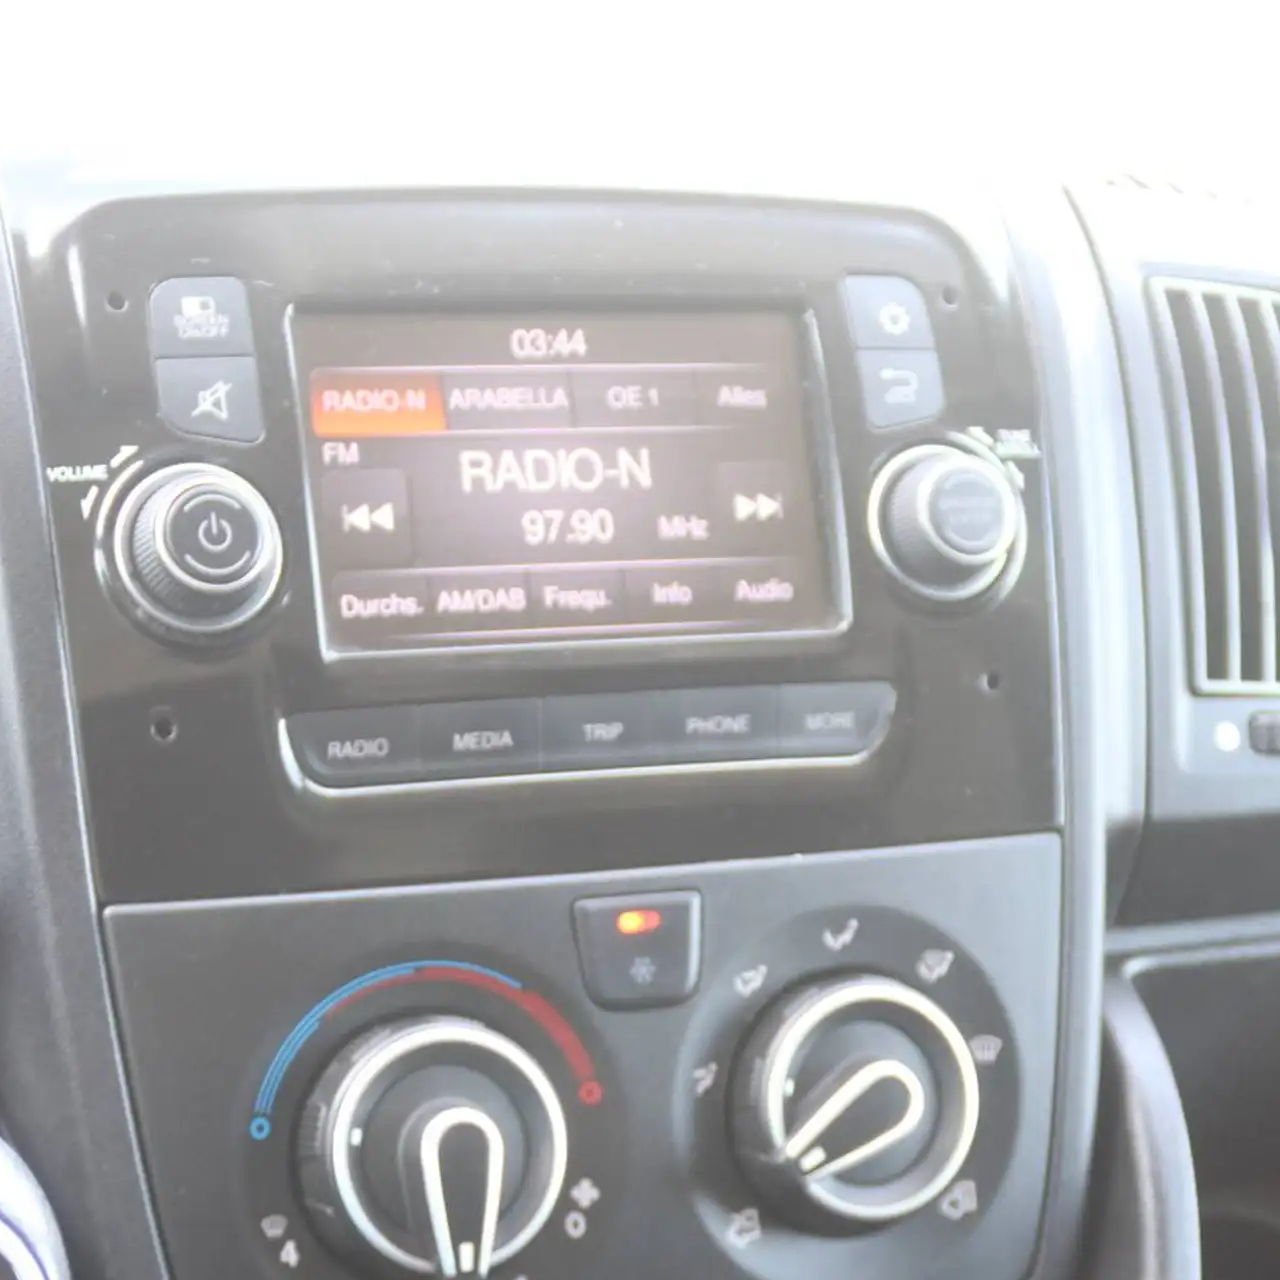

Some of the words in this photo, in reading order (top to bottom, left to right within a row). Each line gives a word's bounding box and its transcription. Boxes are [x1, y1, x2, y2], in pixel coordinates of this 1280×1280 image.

[510, 328, 587, 359] 03:44
[449, 387, 569, 410] ARABELLA
[322, 442, 360, 465] FM
[46, 465, 109, 483] VOLUME
[458, 446, 652, 494] RADIO-N
[522, 508, 615, 546] 97.90
[657, 515, 710, 541] MHz
[436, 587, 527, 612] AM/DAB
[652, 581, 693, 606] Info
[734, 577, 794, 603] Audio
[340, 593, 423, 620] Durchs.
[582, 721, 624, 742] TRIP
[685, 713, 751, 735] PHONE
[327, 737, 390, 760] RADIO
[452, 729, 514, 752] MEDIA
[279, 1239, 300, 1268] 4
